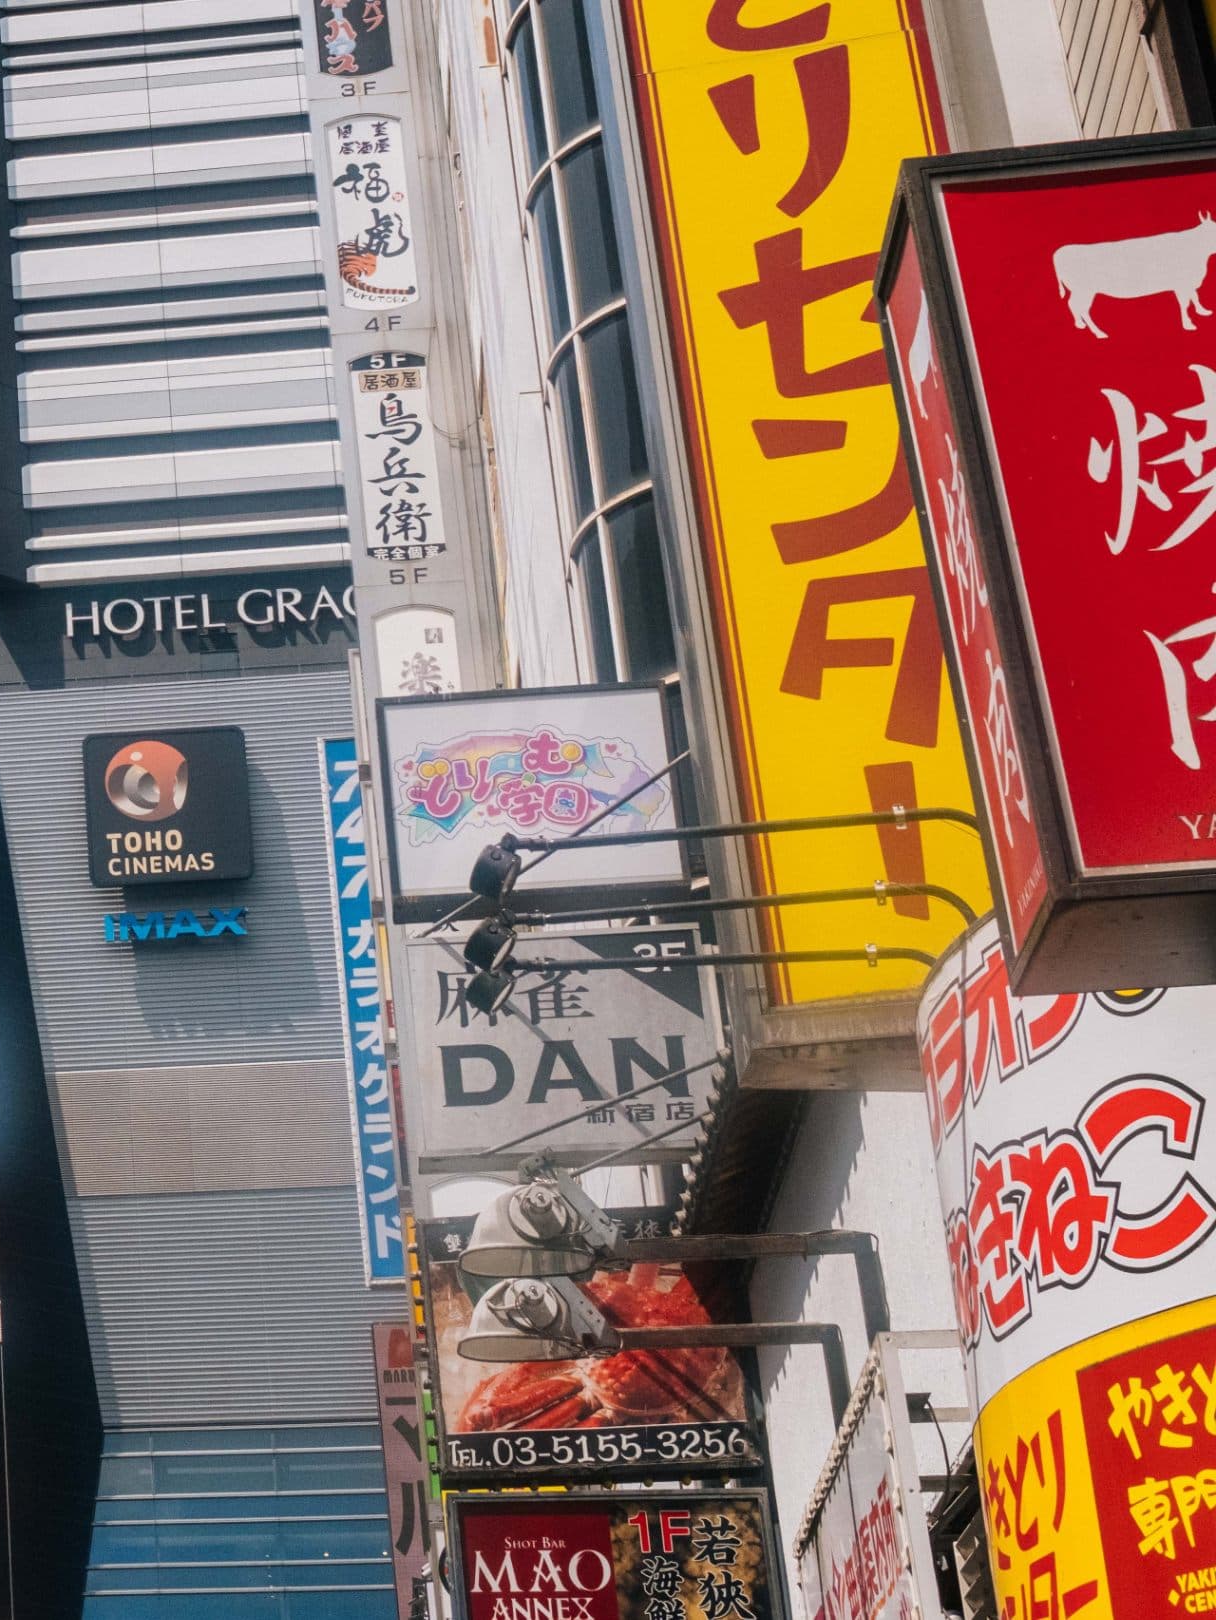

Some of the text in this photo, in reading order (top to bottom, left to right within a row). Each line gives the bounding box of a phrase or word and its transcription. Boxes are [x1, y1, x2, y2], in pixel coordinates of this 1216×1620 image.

[341, 81, 376, 97] 3F
[364, 315, 401, 332] 4F
[370, 355, 406, 369] 5F
[363, 371, 418, 390] 居酒屋
[373, 545, 441, 561] 完全個室
[389, 568, 428, 585] 5F
[65, 593, 227, 637] HOTEL
[106, 829, 183, 854] TOHO
[108, 852, 215, 876] CINEMAS
[103, 907, 249, 943] IMAX
[437, 1035, 694, 1107] DAN
[585, 1102, 695, 1126] 新宿店
[447, 1428, 747, 1467] TEL.03-5155-3256
[628, 1510, 690, 1553] 1F
[470, 1549, 613, 1594] MAO
[493, 1597, 596, 1620] ANNEX
